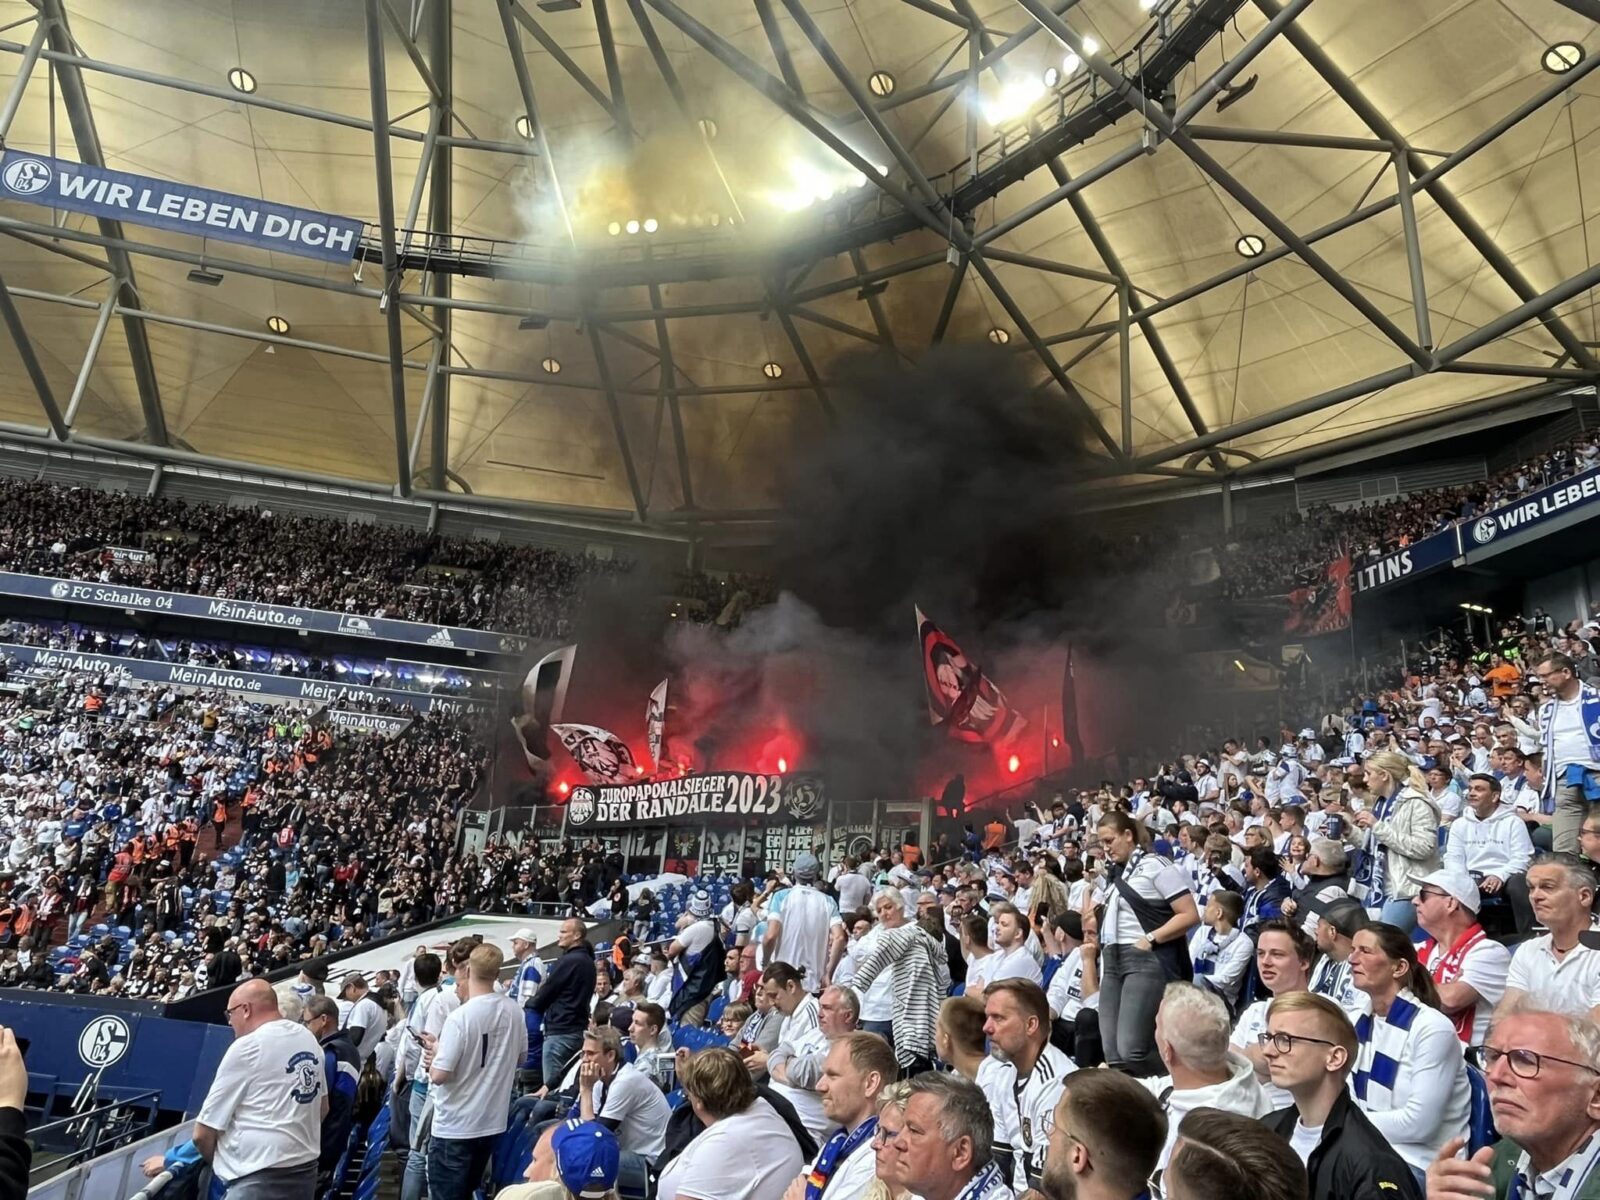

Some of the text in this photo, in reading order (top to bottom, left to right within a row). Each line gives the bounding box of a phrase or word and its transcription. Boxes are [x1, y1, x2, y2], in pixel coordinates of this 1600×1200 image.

[59, 172, 355, 253] WIR LEBEN DICH
[1498, 502, 1540, 531] WIR
[71, 586, 173, 608] FC Schalke 04
[207, 600, 303, 626] MeinAuto.de
[169, 666, 262, 691] MeinAuto.de
[329, 712, 401, 731] MeinAuto.de
[599, 775, 725, 803] EUROPAPOKALSIEGER
[724, 774, 782, 815] 2023
[596, 793, 724, 822] DER RANDALE
